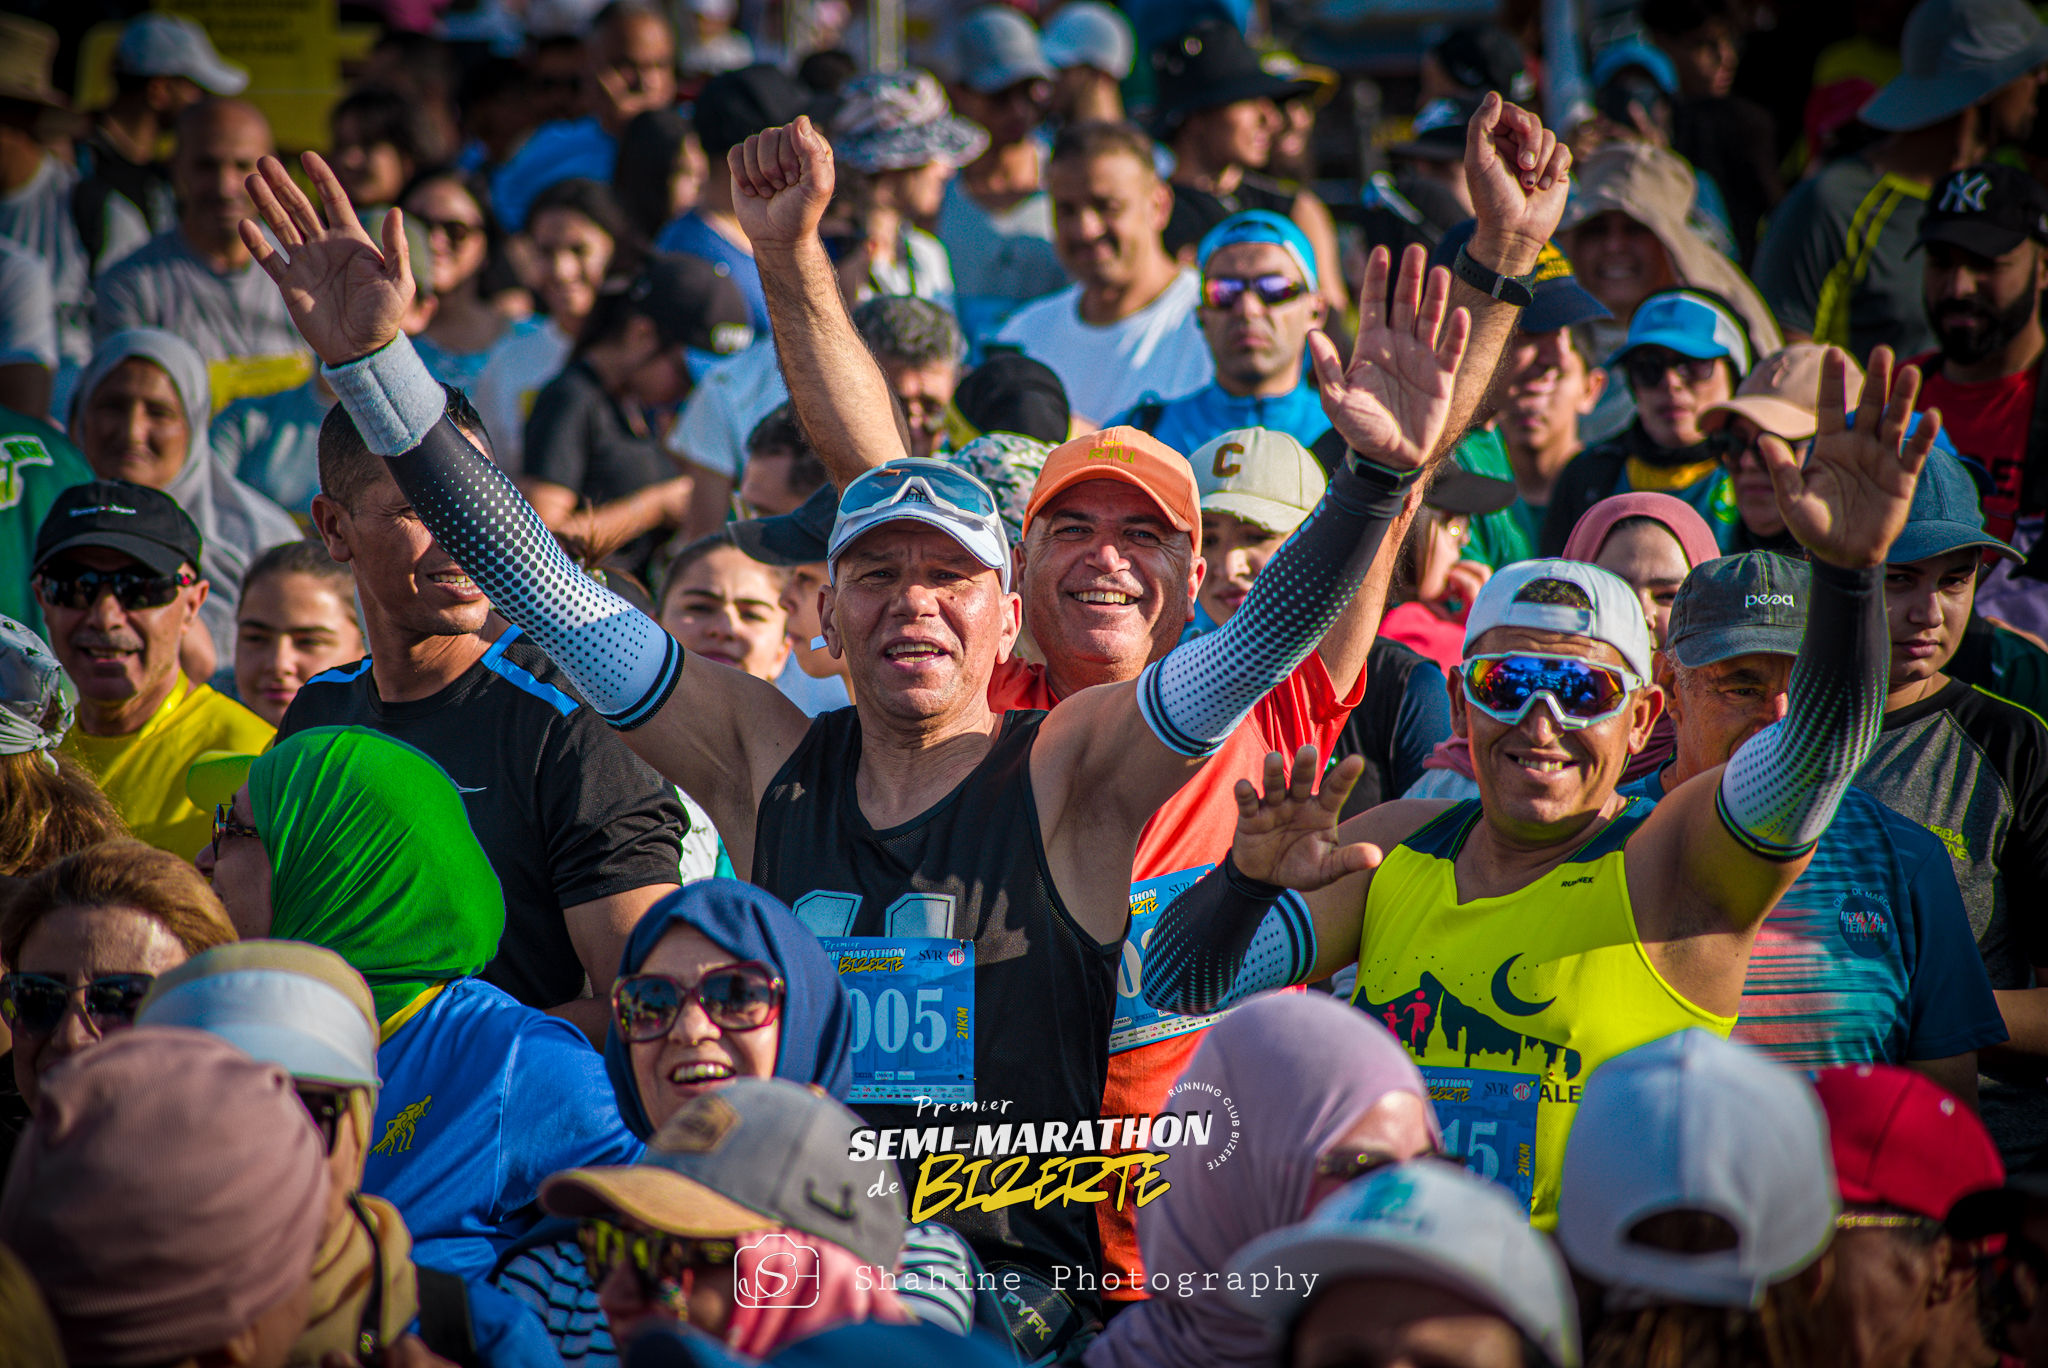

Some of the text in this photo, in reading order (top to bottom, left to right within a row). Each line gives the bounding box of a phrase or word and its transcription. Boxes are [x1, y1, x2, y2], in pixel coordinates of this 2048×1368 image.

[1088, 447, 1135, 464] RIU
[1212, 443, 1245, 478] C
[1865, 891, 1892, 913] MARC
[919, 950, 944, 961] SVR
[956, 1006, 969, 1040] 21KM
[1484, 1083, 1509, 1095] SVR
[1517, 1143, 1531, 1177] 21KM
